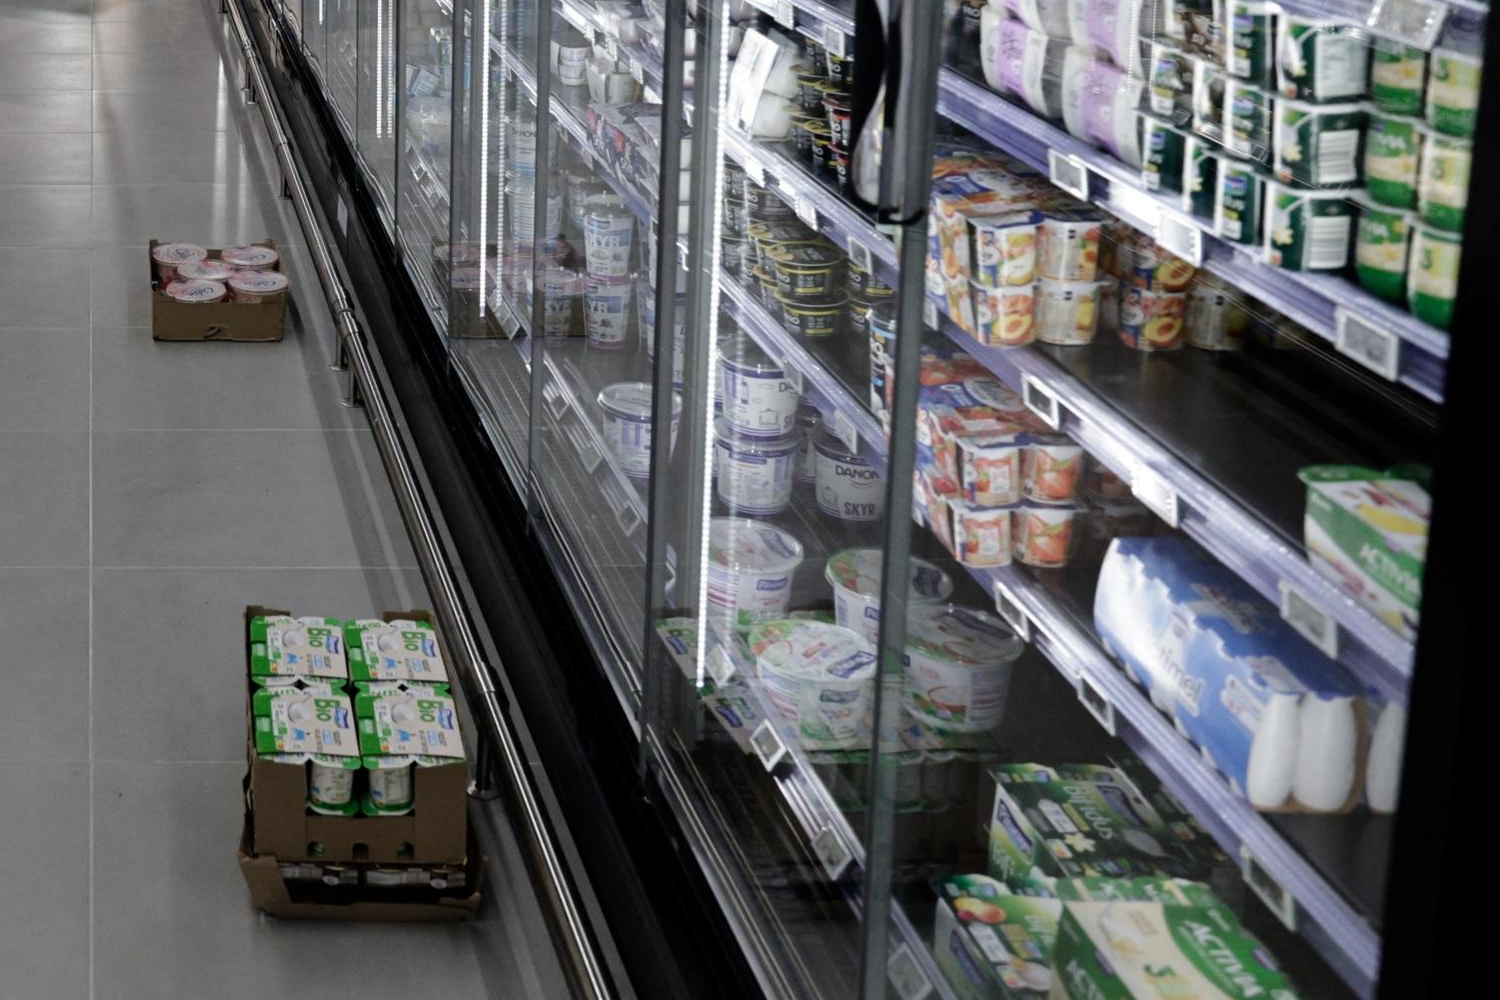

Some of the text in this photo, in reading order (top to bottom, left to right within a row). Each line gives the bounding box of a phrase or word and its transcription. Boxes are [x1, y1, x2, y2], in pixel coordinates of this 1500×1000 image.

[835, 463, 879, 480] DANON
[844, 501, 876, 516] SKYR
[1184, 919, 1265, 997] ACTIVIA
